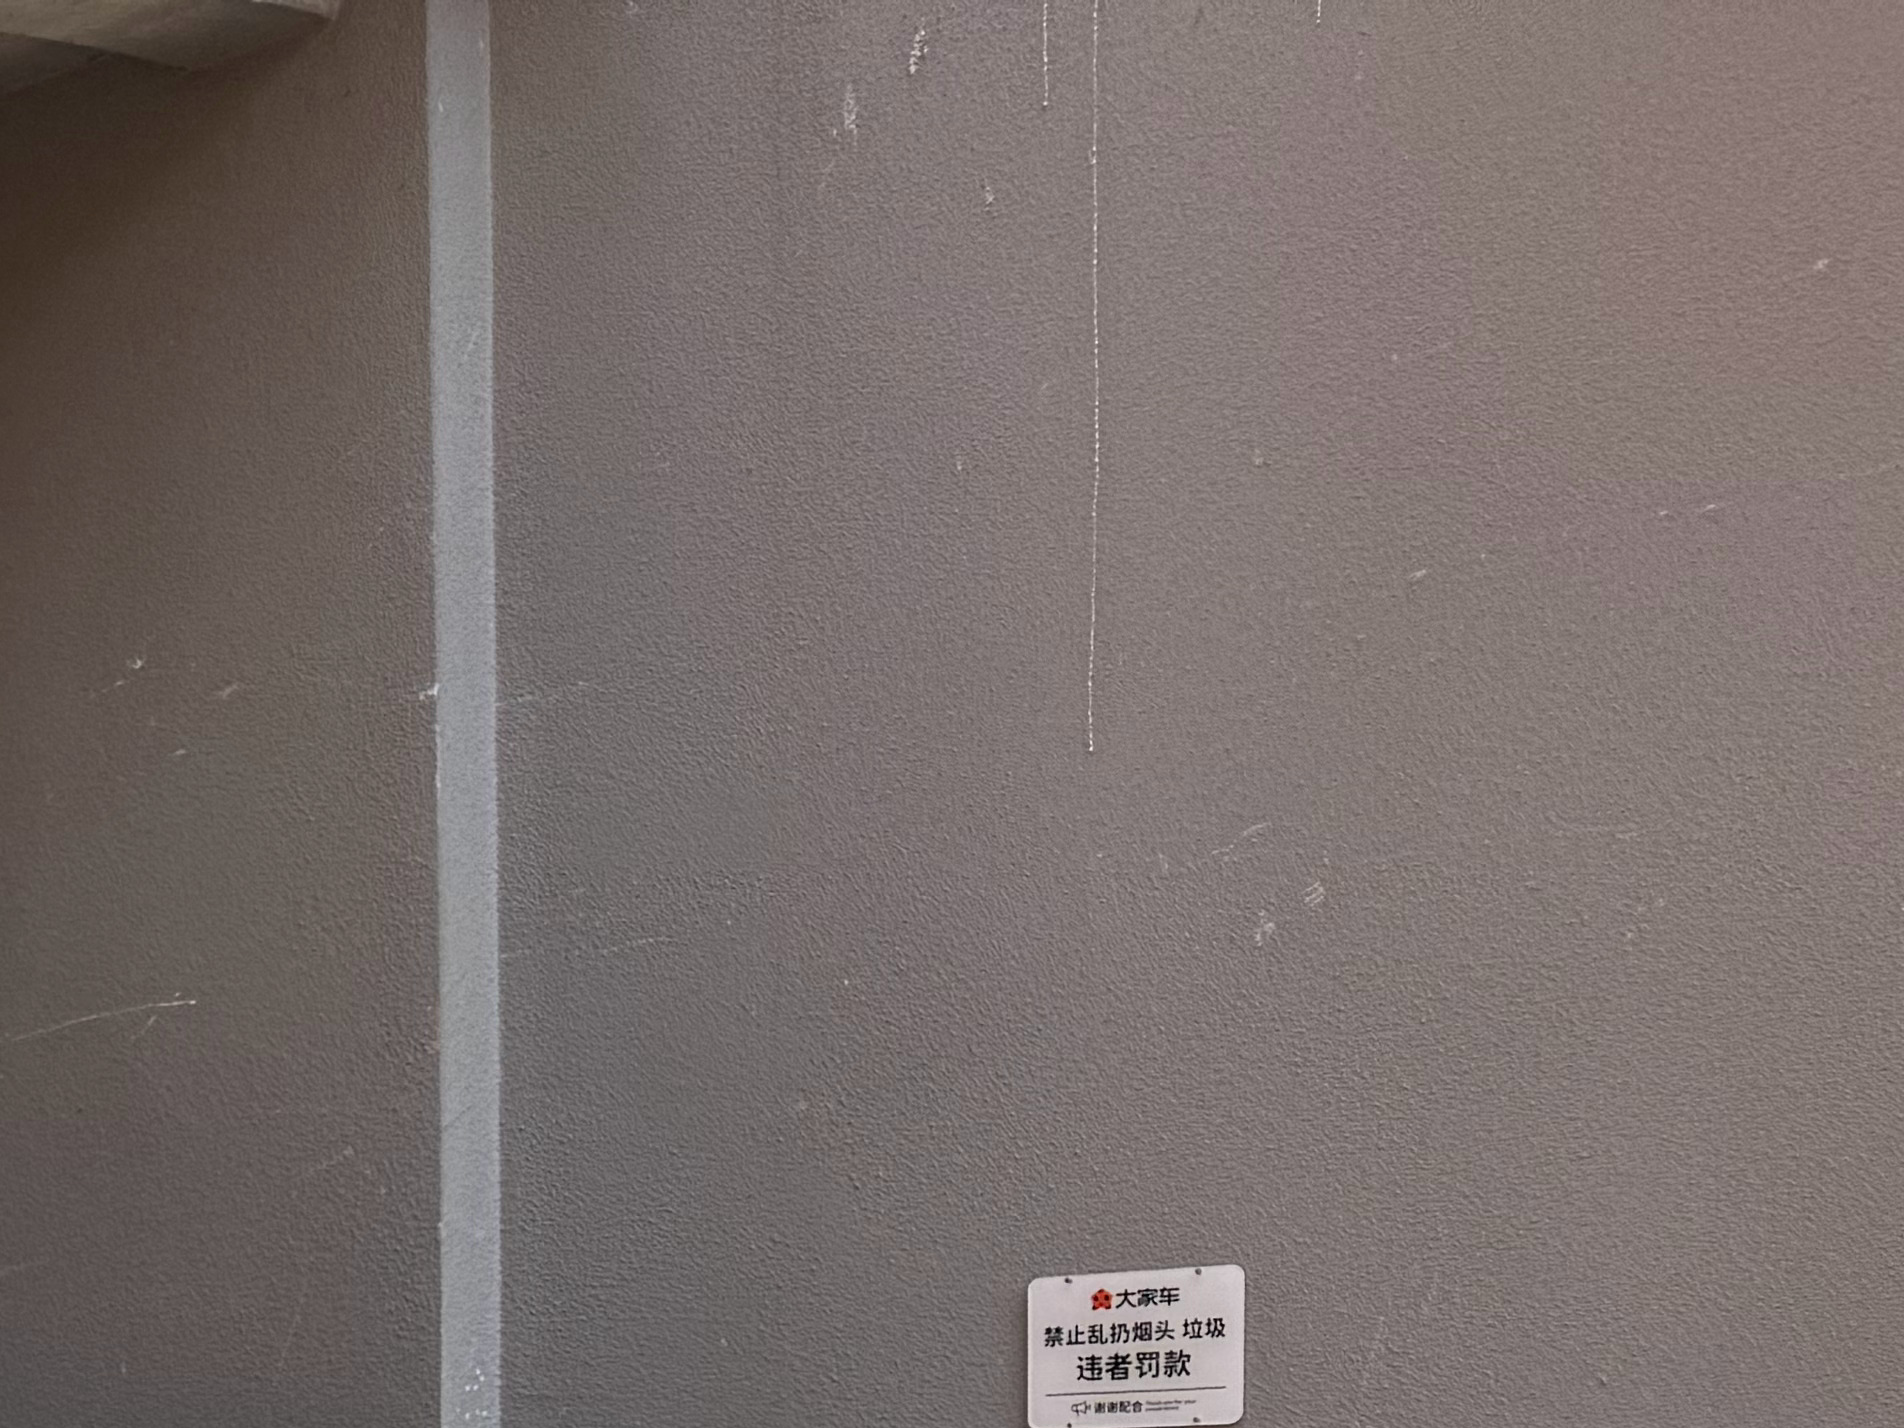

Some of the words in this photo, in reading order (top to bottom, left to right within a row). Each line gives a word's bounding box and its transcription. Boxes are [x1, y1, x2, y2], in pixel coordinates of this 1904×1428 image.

[1115, 1286, 1181, 1309] 大家车
[1044, 1320, 1175, 1348] 禁止乱扔烟头
[1182, 1317, 1226, 1340] 垃圾
[1076, 1349, 1192, 1382] 违者罚款
[1094, 1400, 1143, 1414] 谢谢配合
